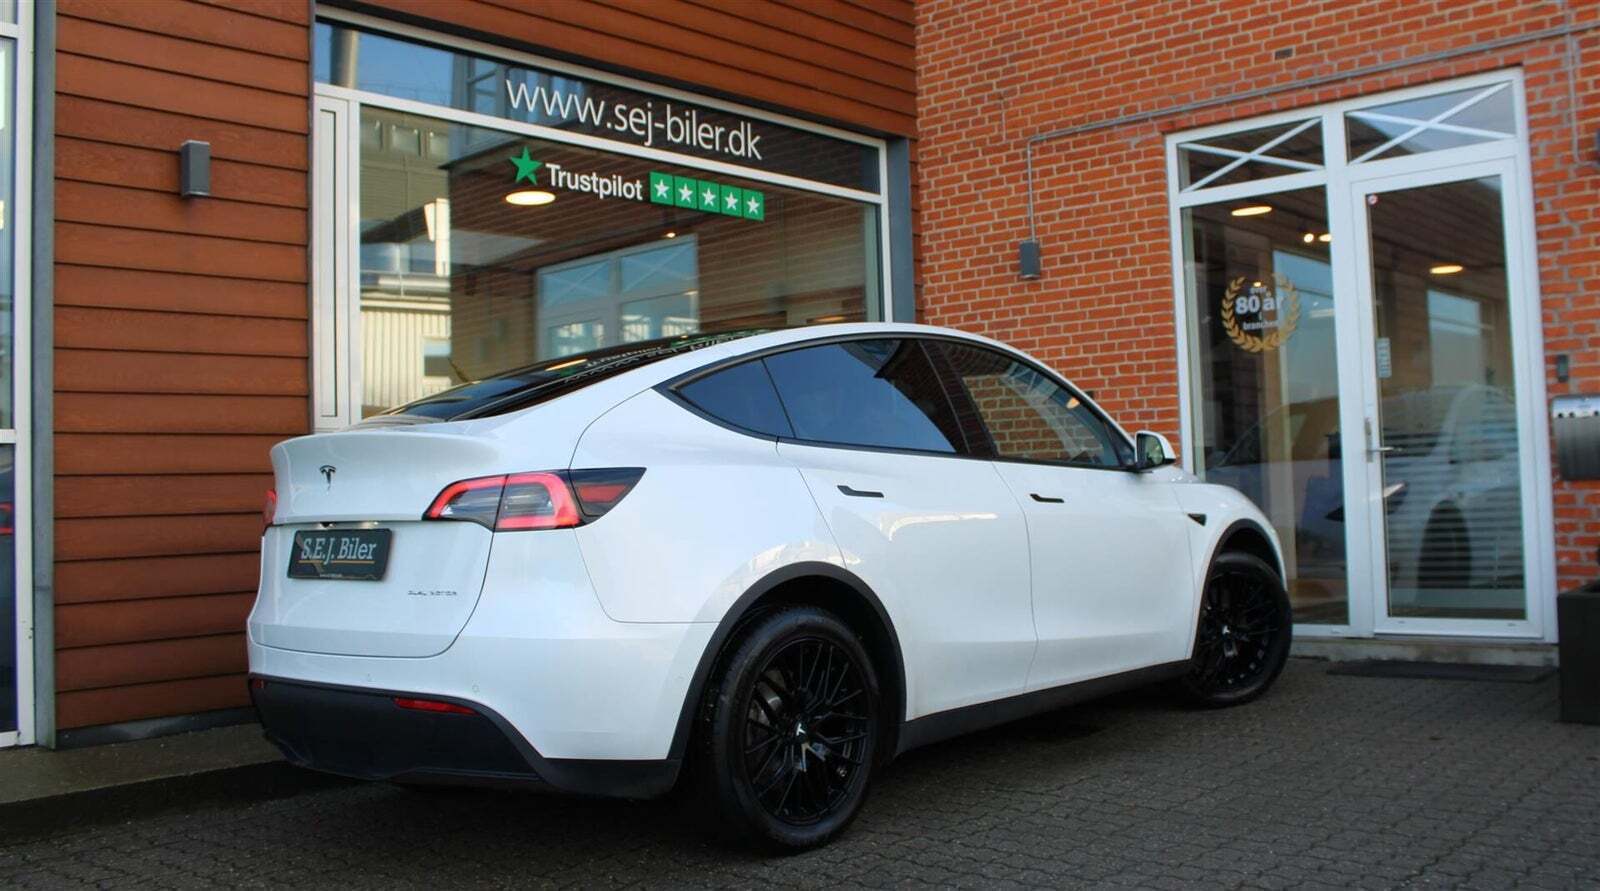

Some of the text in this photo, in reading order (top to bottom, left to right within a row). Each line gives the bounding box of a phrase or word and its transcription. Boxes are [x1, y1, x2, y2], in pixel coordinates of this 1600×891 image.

[505, 79, 762, 160] www.sej-biler.dk
[545, 162, 643, 200] Trustpilot
[1235, 296, 1260, 315] 80
[301, 537, 377, 564] S.E.J. Biler
